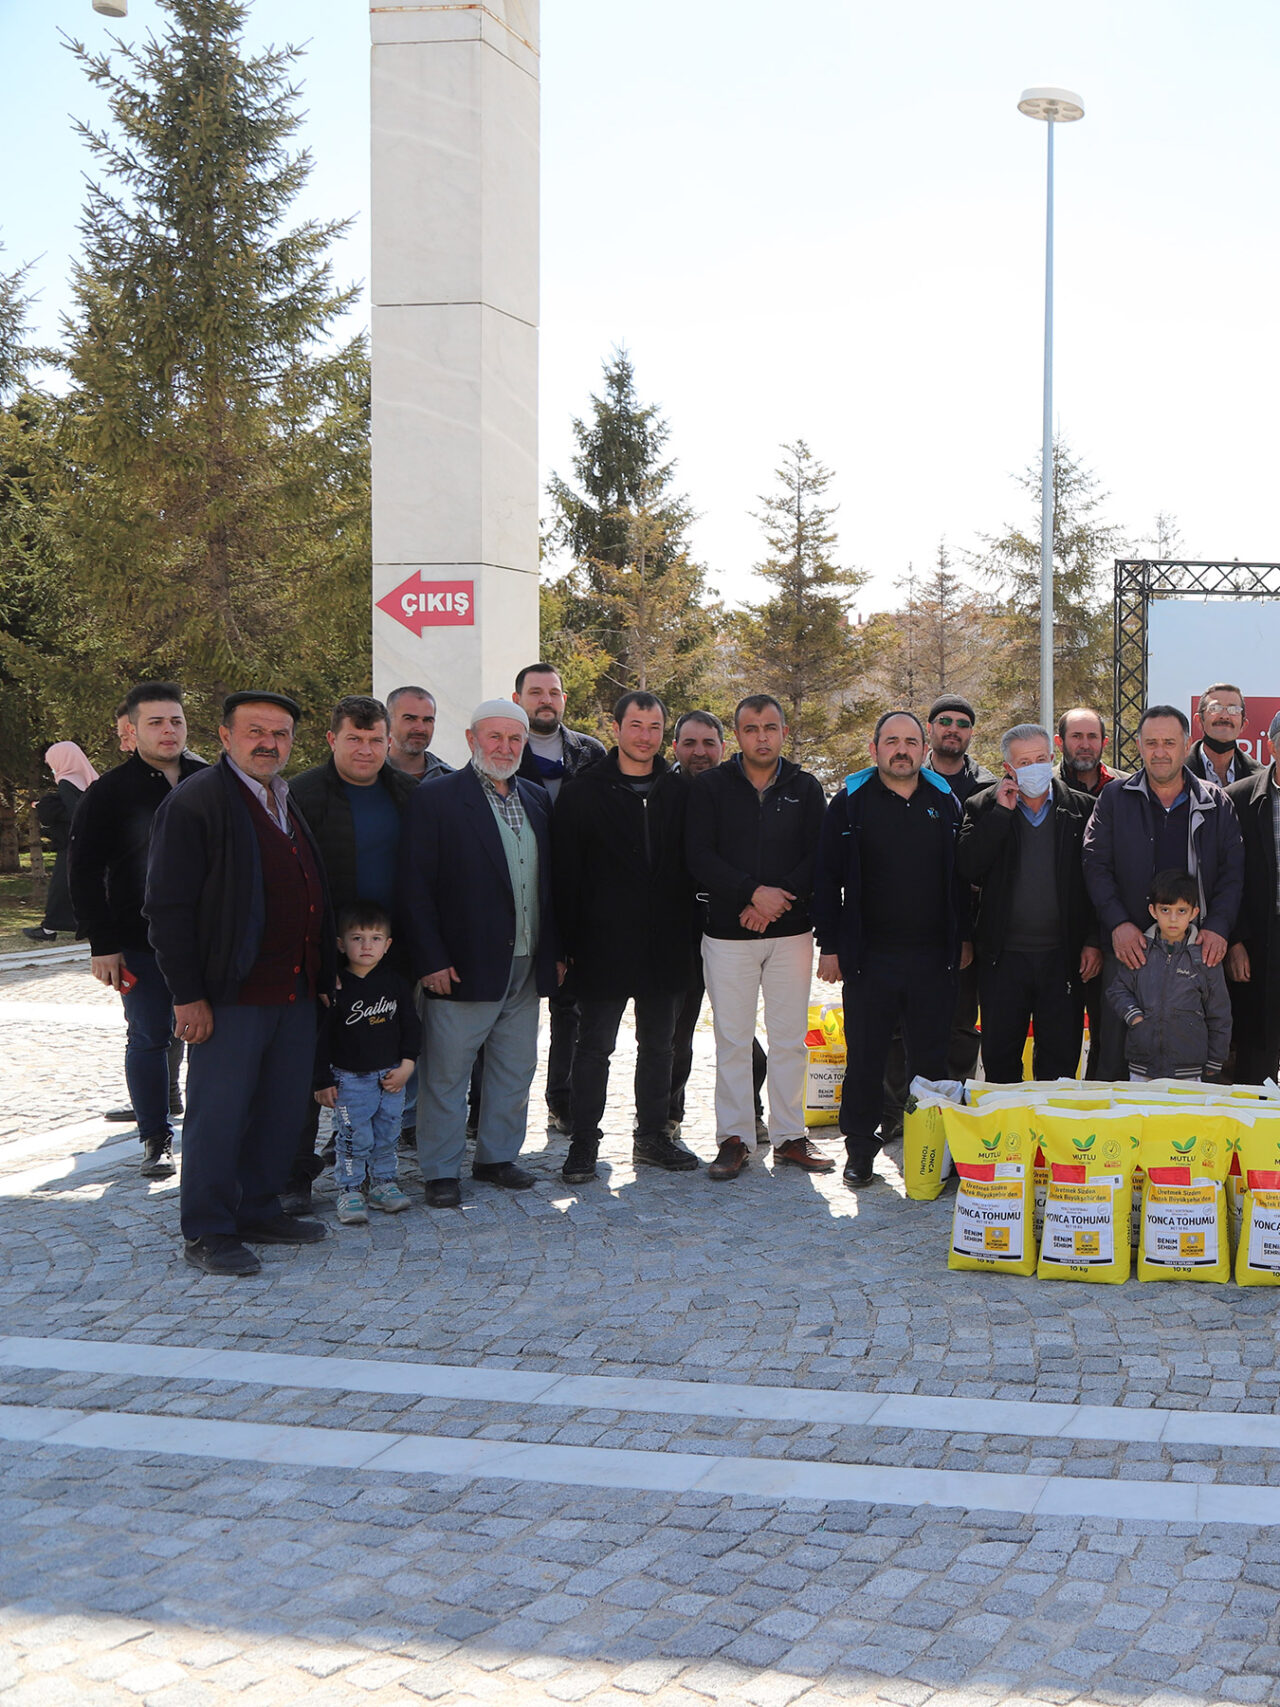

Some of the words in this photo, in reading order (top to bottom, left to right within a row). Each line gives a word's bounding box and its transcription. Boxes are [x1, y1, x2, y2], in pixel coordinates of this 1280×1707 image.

[401, 592, 470, 617] ÇIKIŞ
[345, 996, 397, 1025] Sailing
[810, 1073, 832, 1081] YONCA
[982, 1212, 1020, 1220] TOHUMU
[1071, 1215, 1110, 1224] TOHUMU
[1147, 1215, 1175, 1225] YONCA
[1178, 1216, 1215, 1226] TOHUMU
